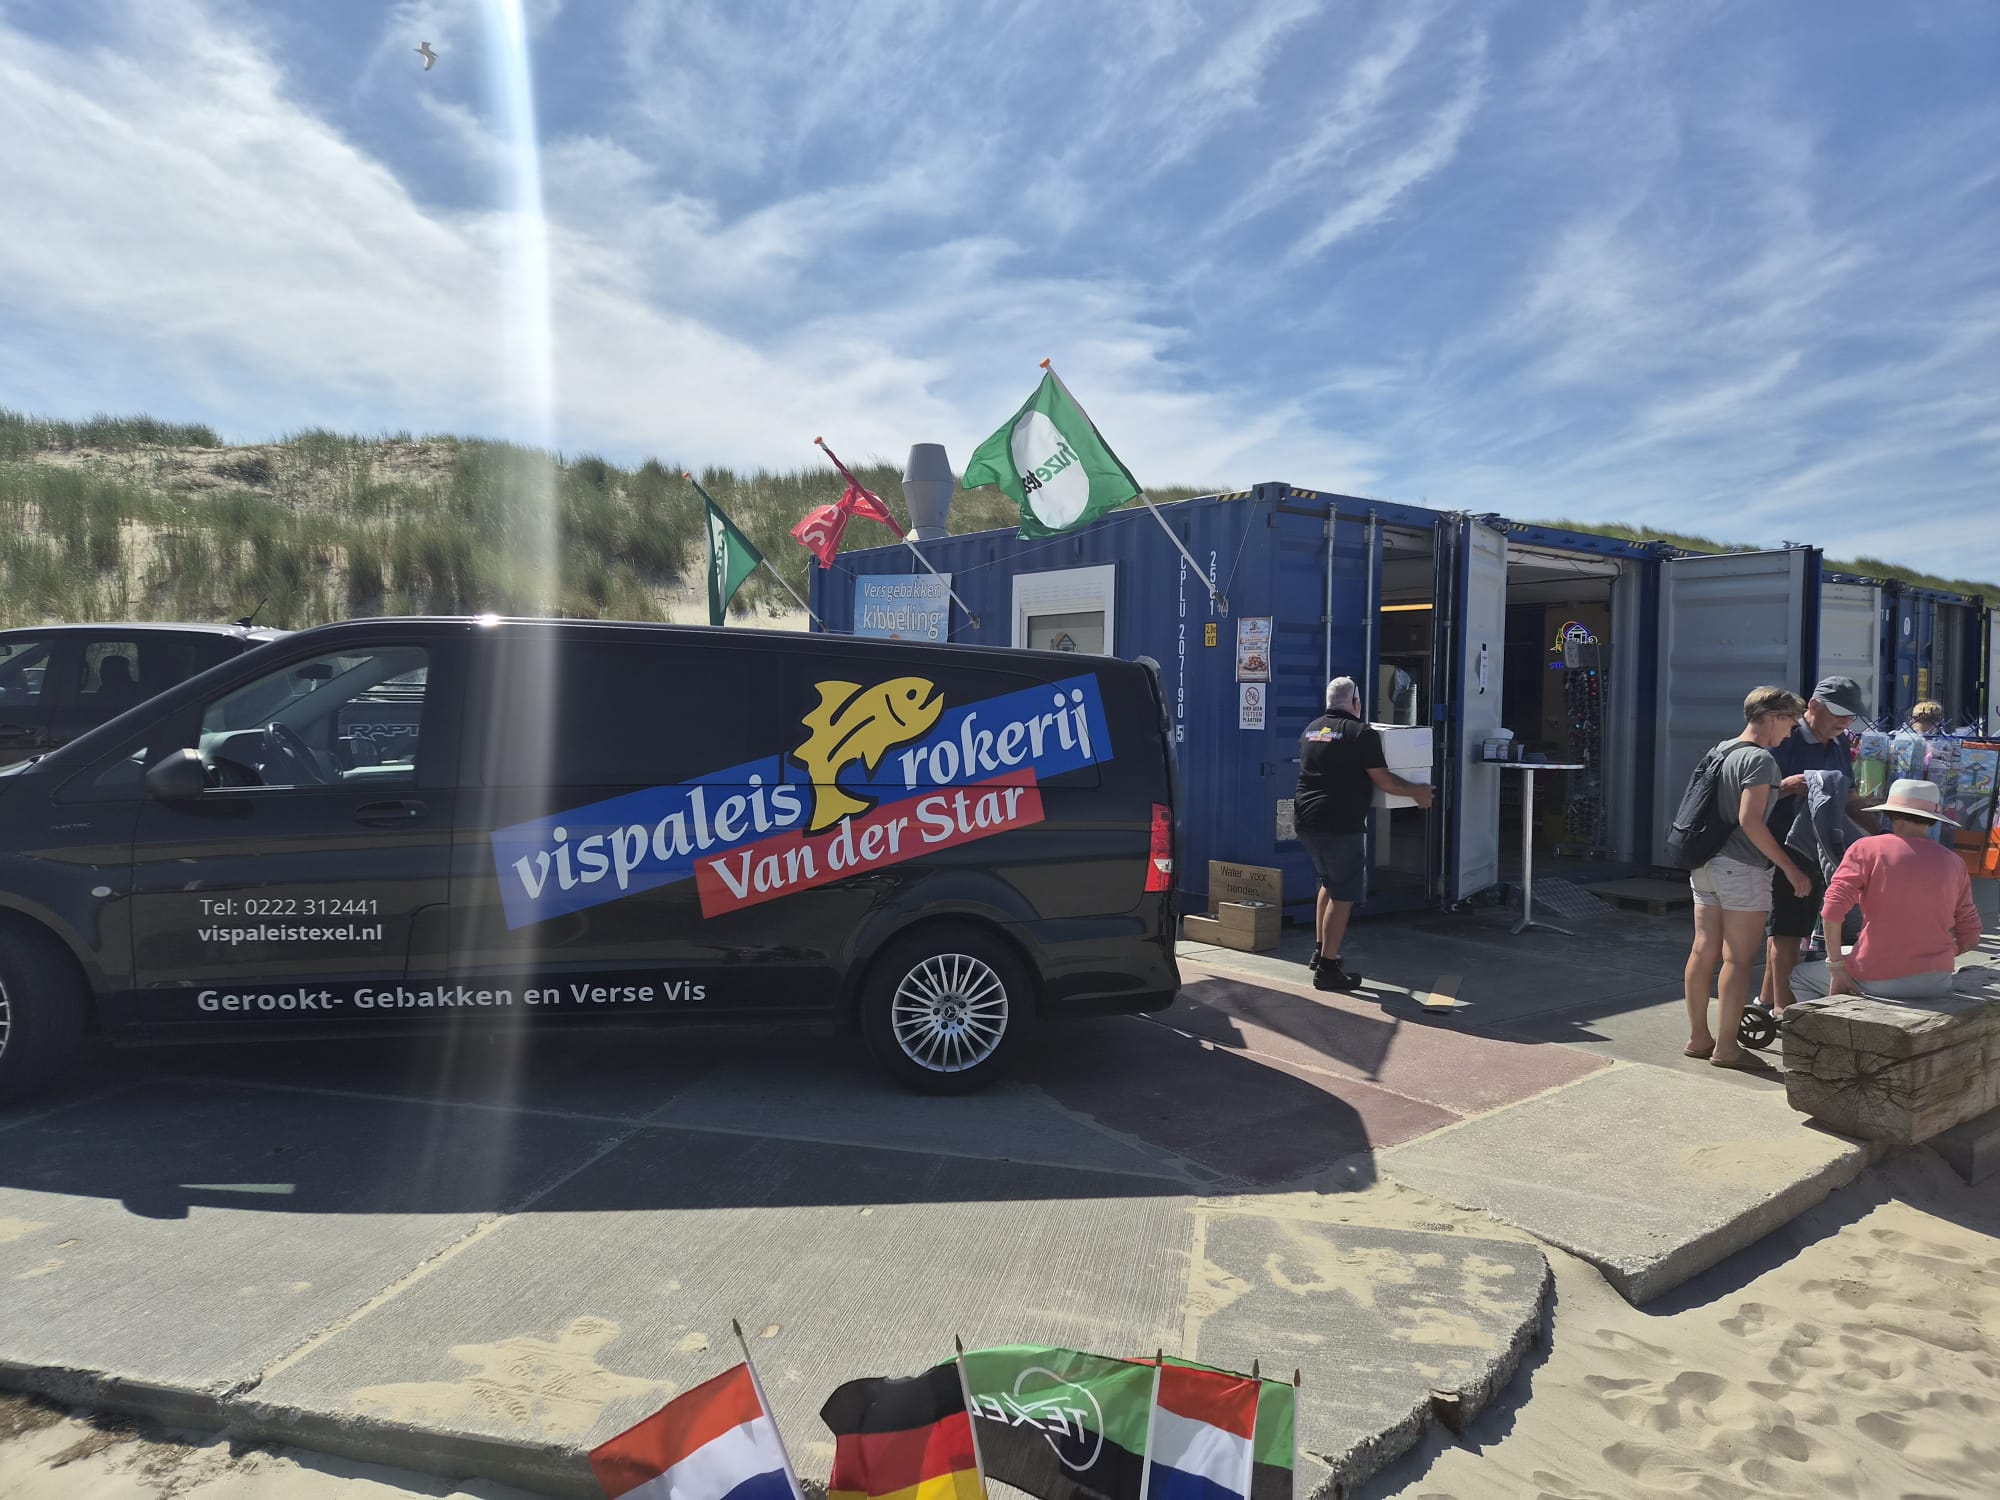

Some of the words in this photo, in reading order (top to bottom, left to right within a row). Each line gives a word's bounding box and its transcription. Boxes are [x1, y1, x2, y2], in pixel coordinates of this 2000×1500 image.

[1179, 553, 1187, 618] CPLU
[863, 604, 942, 639] kibbeling
[1177, 623, 1185, 719] 207190
[1176, 725, 1184, 742] 5
[511, 774, 802, 900] vispaleis
[898, 688, 1092, 791] rokerij
[708, 844, 820, 900] Van
[827, 815, 909, 870] der
[915, 786, 1025, 843] Star
[1220, 865, 1243, 878] Water
[1249, 872, 1268, 882] voor
[200, 898, 239, 916] Tel:
[245, 898, 298, 916] 0222
[303, 898, 378, 916] 312441
[198, 923, 383, 946] vispaleistexel.nl
[197, 988, 344, 1011] Gerookt-
[353, 985, 513, 1009] Gebakken
[523, 986, 560, 1006] en
[570, 982, 654, 1004] Verse
[663, 980, 706, 1001] Vis
